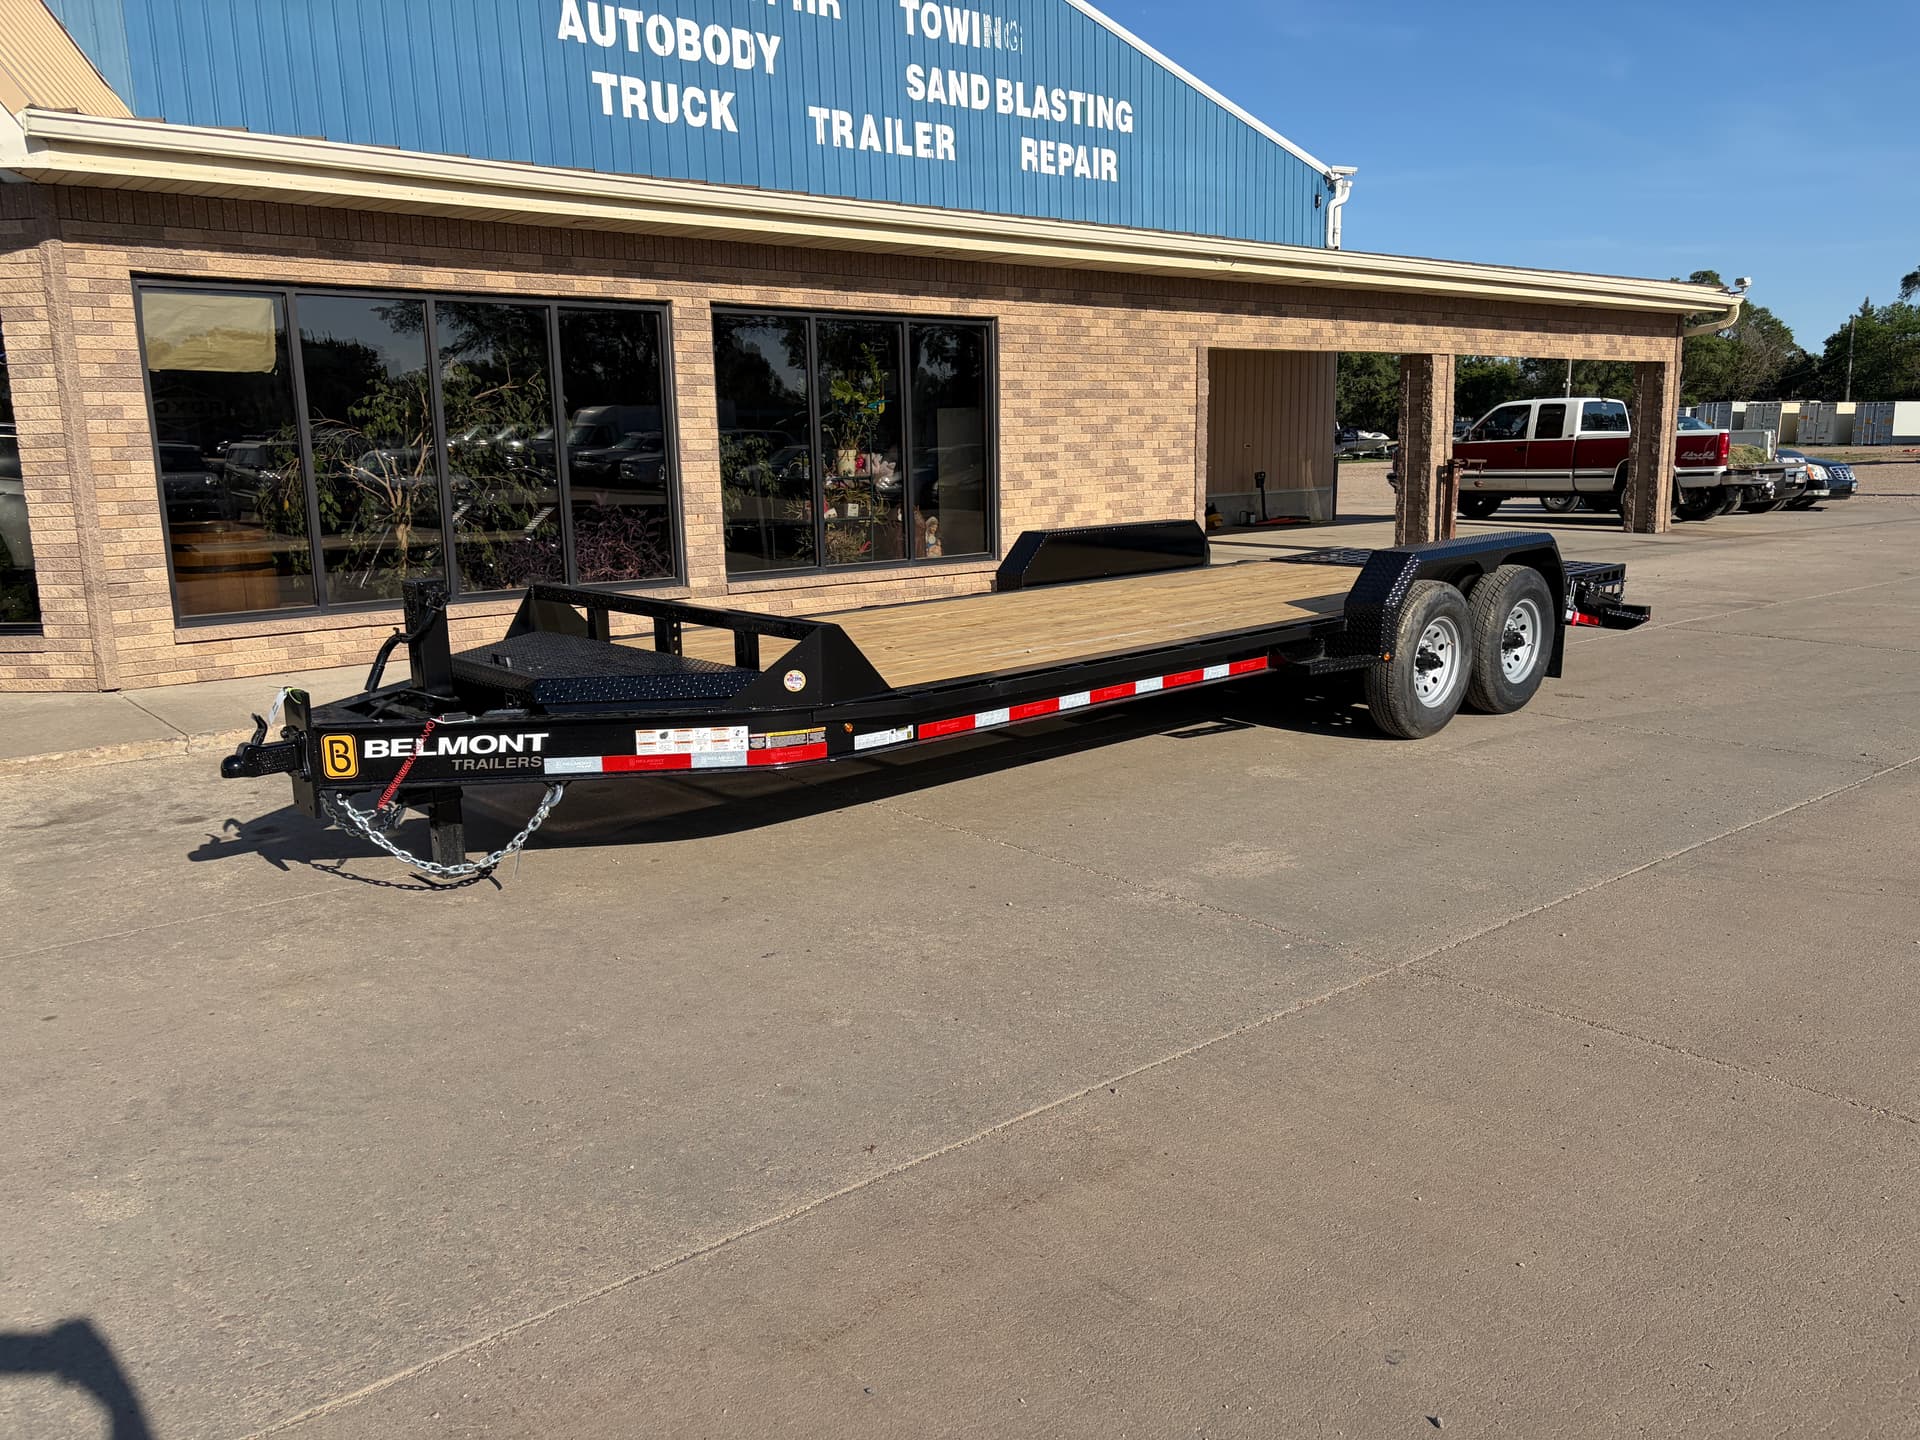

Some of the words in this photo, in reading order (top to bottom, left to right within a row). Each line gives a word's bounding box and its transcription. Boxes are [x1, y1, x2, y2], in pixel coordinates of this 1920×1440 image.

[557, 0, 781, 75] AUTOBODY
[591, 70, 739, 133] TRUCK
[808, 105, 956, 161] TRAILER
[1020, 136, 1119, 182] REPAIR
[363, 732, 549, 759] BELMONT
[451, 755, 543, 772] TRAILERS
